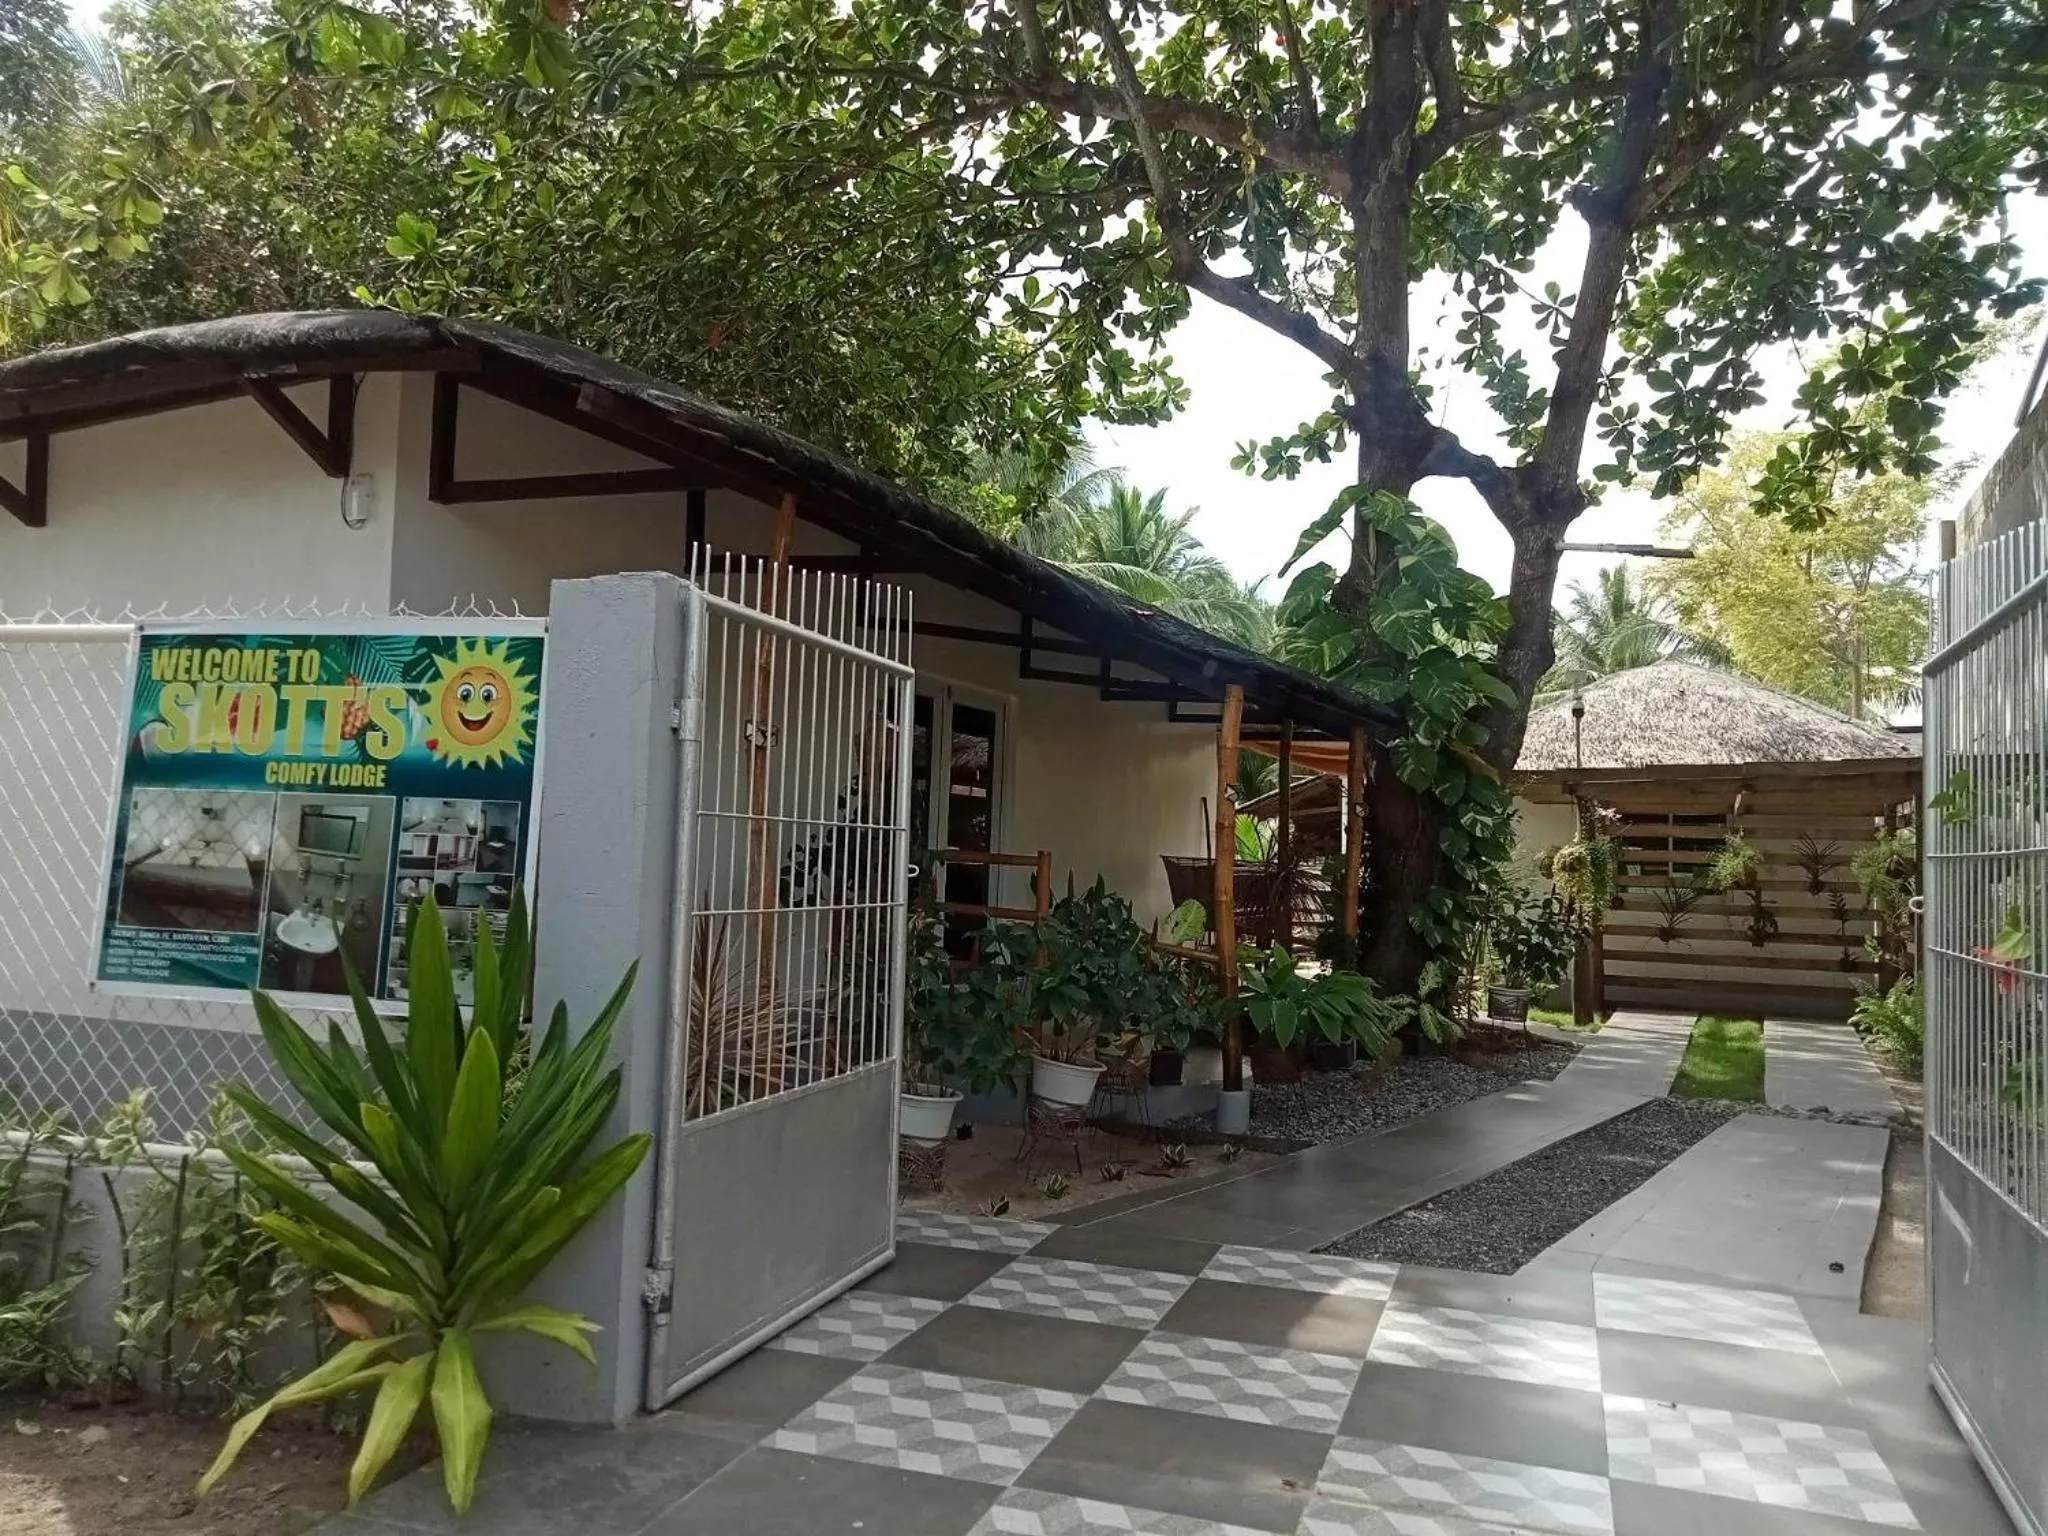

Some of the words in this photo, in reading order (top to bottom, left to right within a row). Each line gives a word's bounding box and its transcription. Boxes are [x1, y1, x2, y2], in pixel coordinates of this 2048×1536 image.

[151, 648, 281, 682] WELCOME
[286, 649, 321, 683] TO
[156, 681, 407, 760] SKOTT'S
[265, 761, 328, 785] COMFY
[329, 763, 387, 788] LODGE
